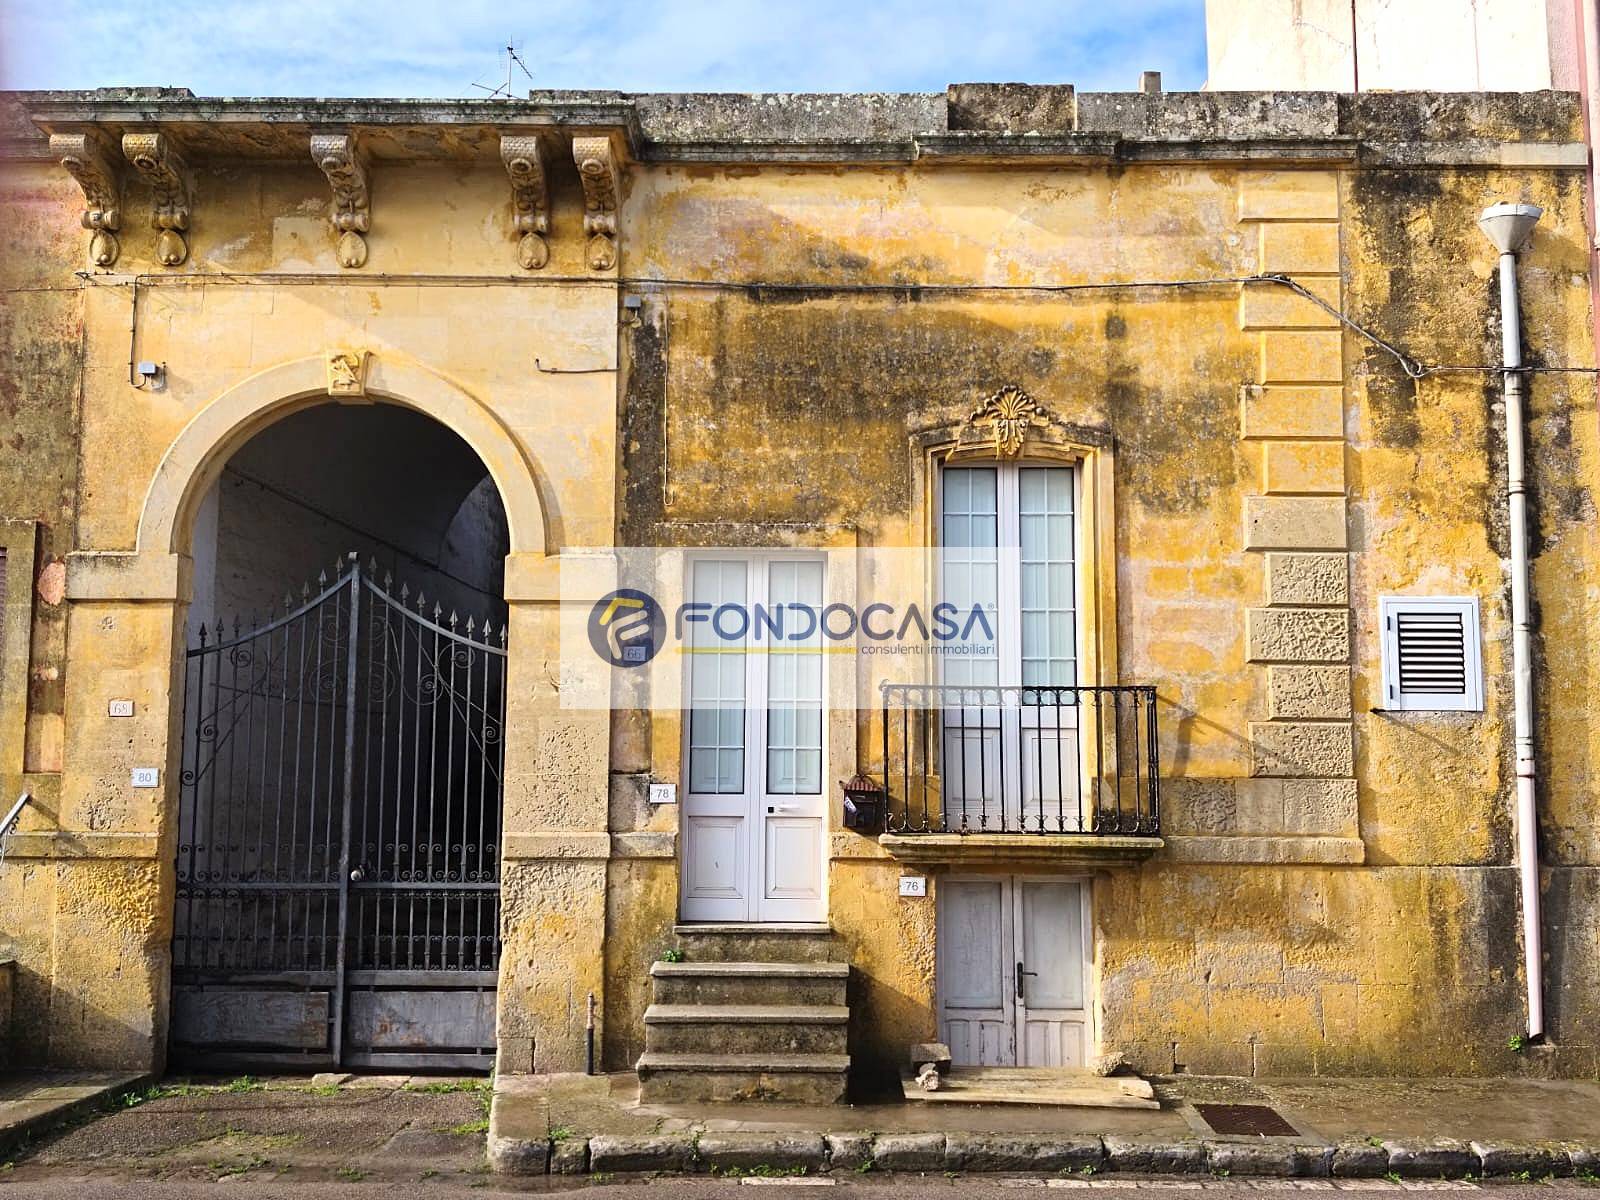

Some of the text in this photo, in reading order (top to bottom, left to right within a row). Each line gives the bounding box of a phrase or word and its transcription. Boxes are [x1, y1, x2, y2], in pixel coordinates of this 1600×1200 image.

[627, 648, 641, 658] 66
[138, 772, 152, 782] 80
[656, 788, 669, 799] 78
[905, 881, 919, 891] 76
